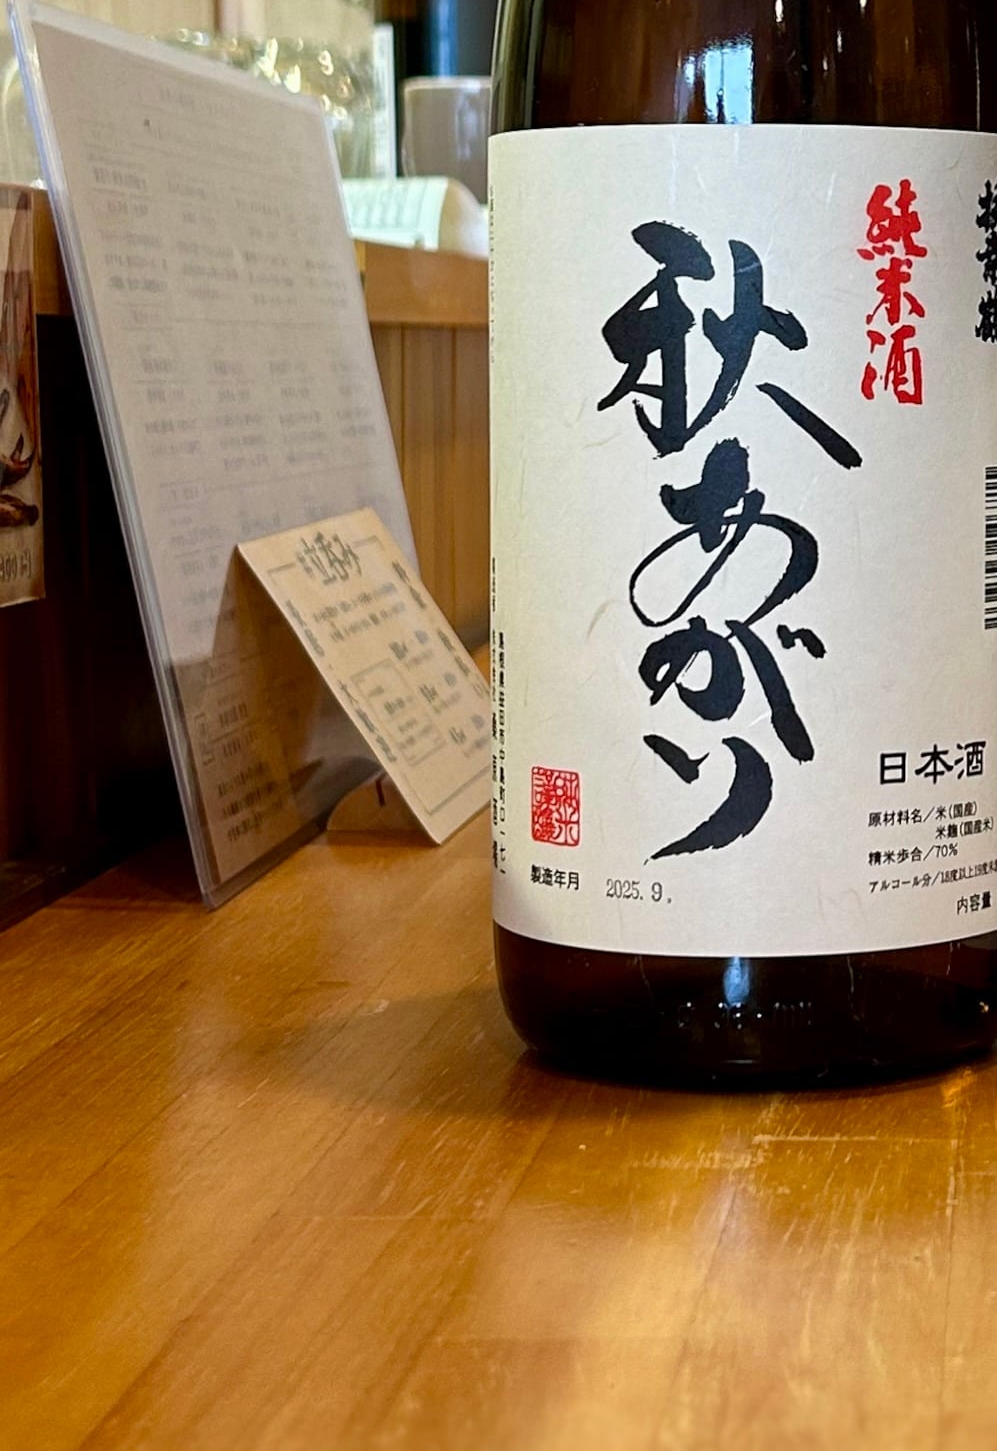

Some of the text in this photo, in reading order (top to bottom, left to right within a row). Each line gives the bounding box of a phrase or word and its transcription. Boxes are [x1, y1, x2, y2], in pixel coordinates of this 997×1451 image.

[858, 179, 927, 405] 純米酒
[598, 219, 862, 866] 秋あがり
[880, 740, 987, 786] 日本酒
[868, 843, 958, 866] 精米歩合/70%
[530, 864, 579, 891] 製造年月
[606, 878, 644, 901] 2025.
[957, 891, 992, 915] 内容量
